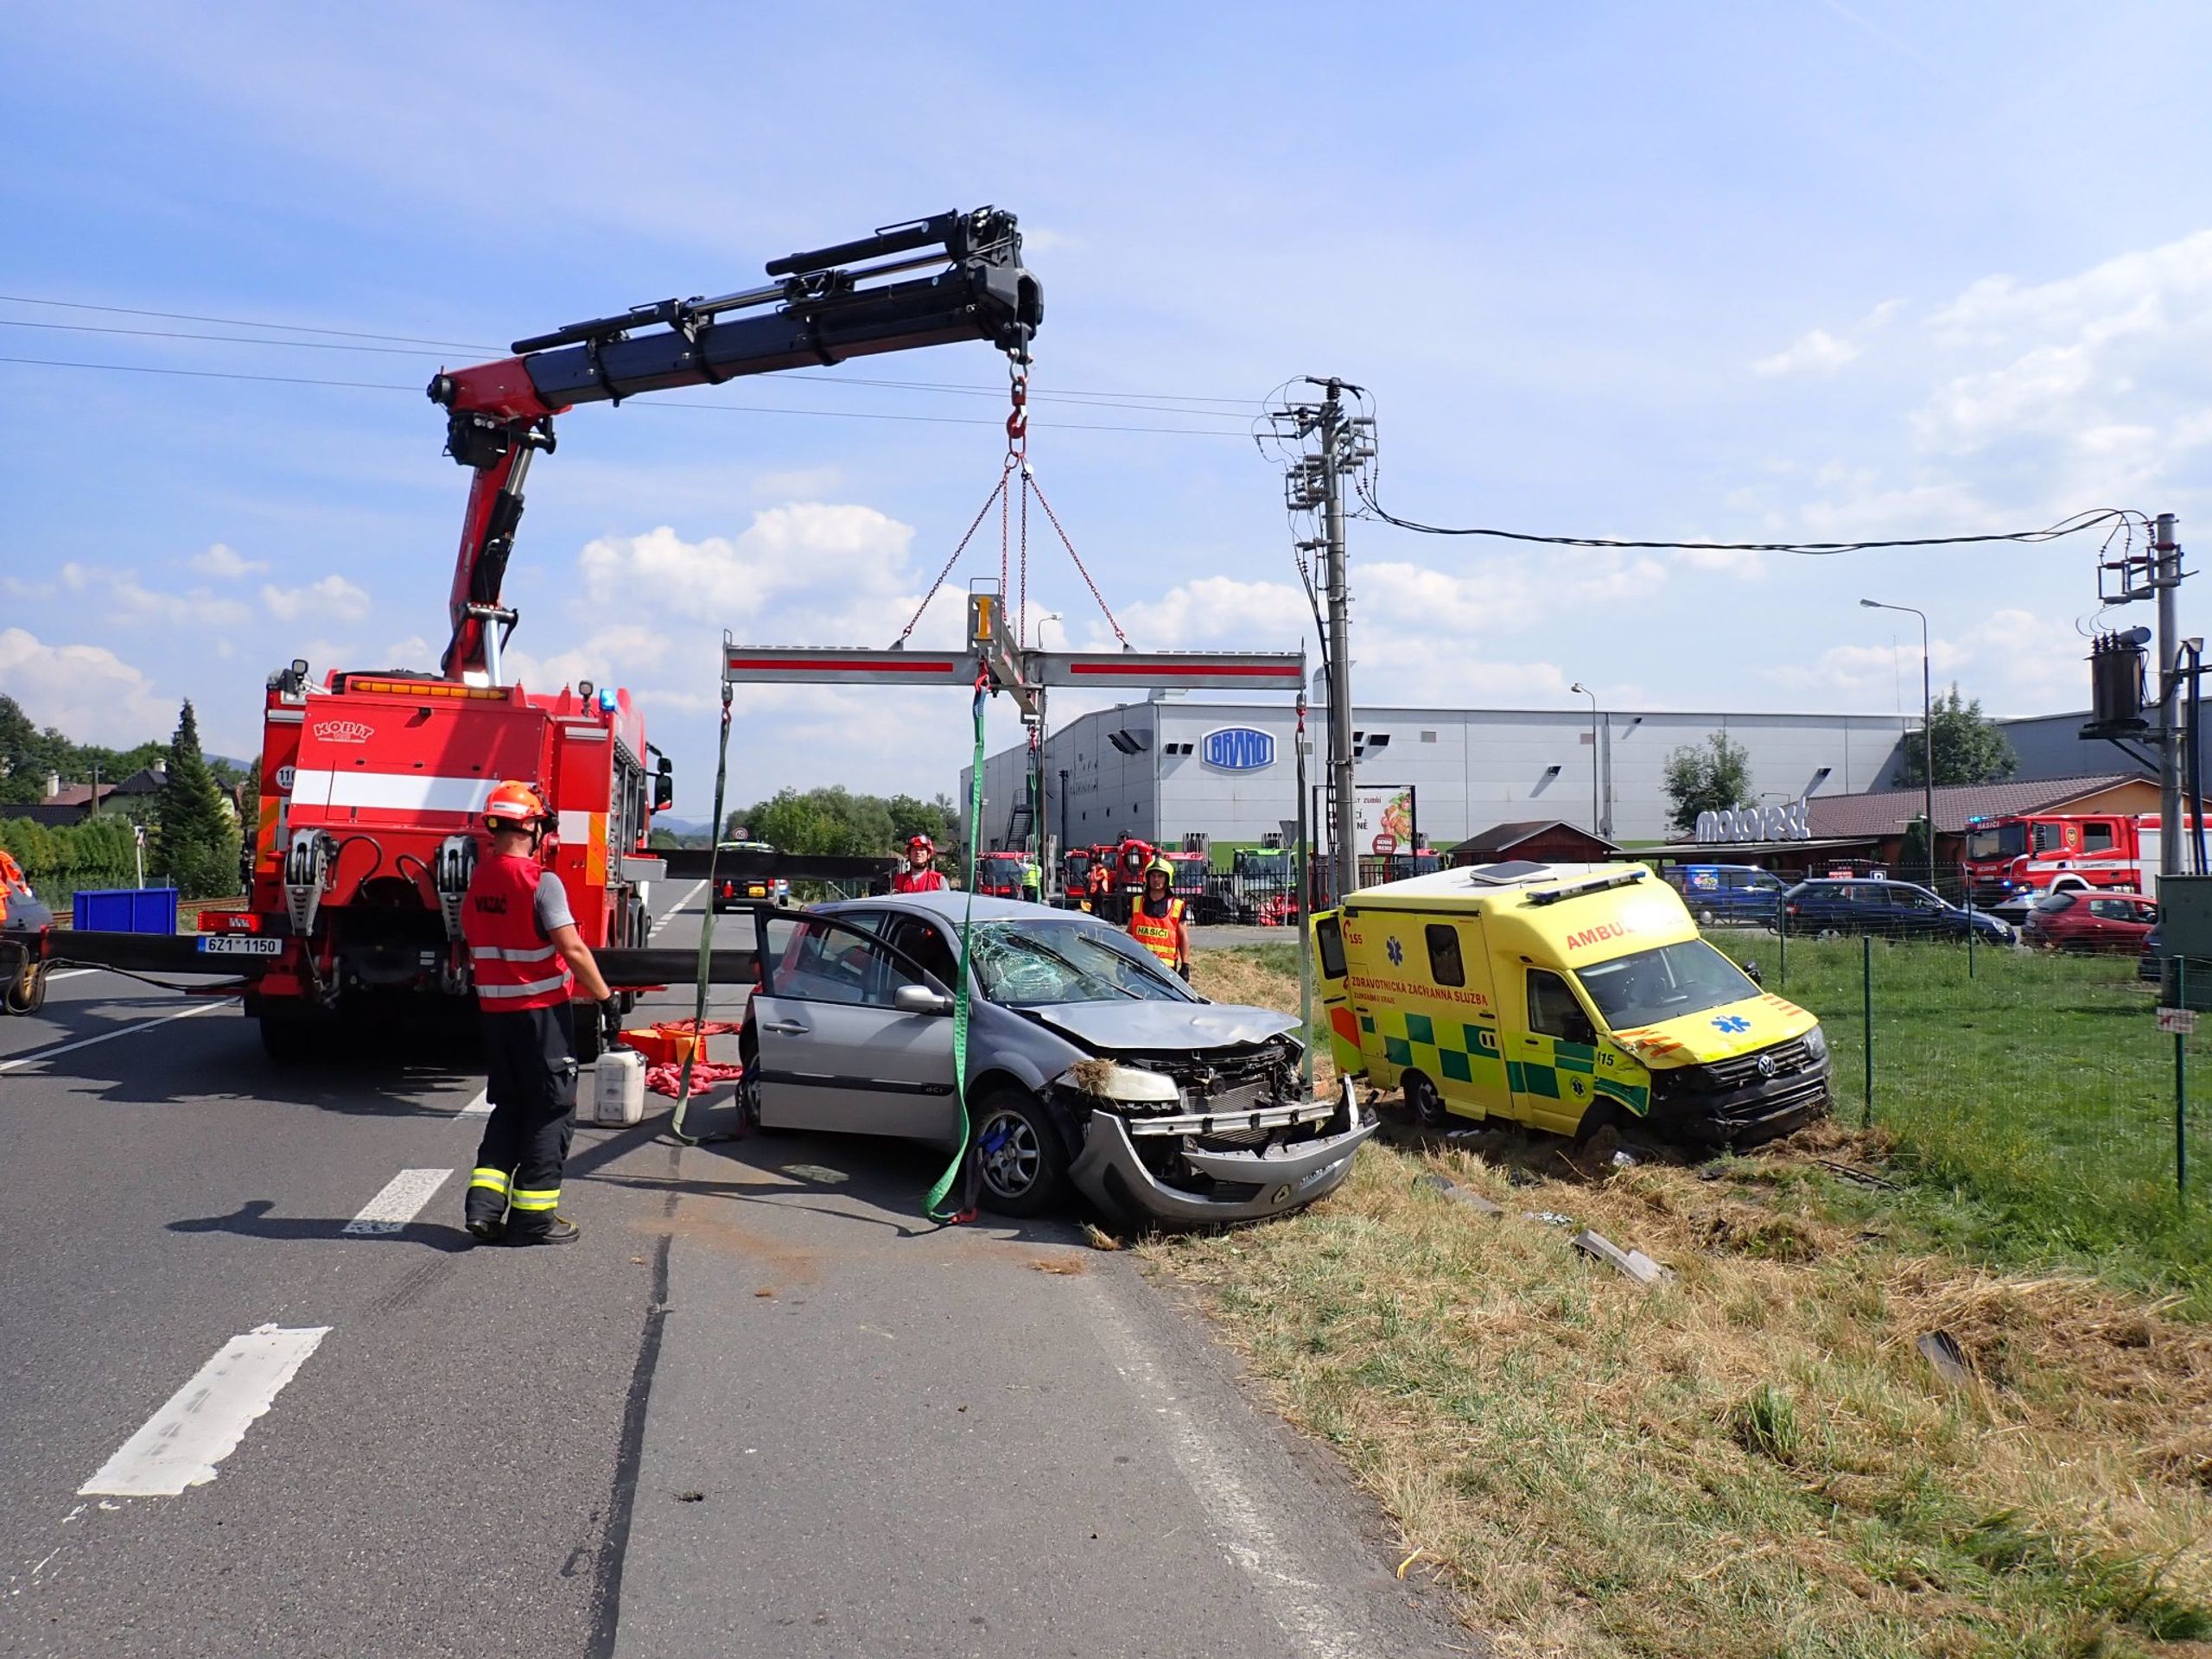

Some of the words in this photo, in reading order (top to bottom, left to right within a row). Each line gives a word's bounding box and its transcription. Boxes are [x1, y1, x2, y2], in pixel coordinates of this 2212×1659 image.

[314, 721, 374, 740] KOBIT
[1211, 731, 1267, 766] BRANO
[1695, 797, 1811, 842] motorest
[208, 938, 232, 951] 6Z1
[244, 940, 276, 952] 1150
[1349, 933, 1363, 944] 155
